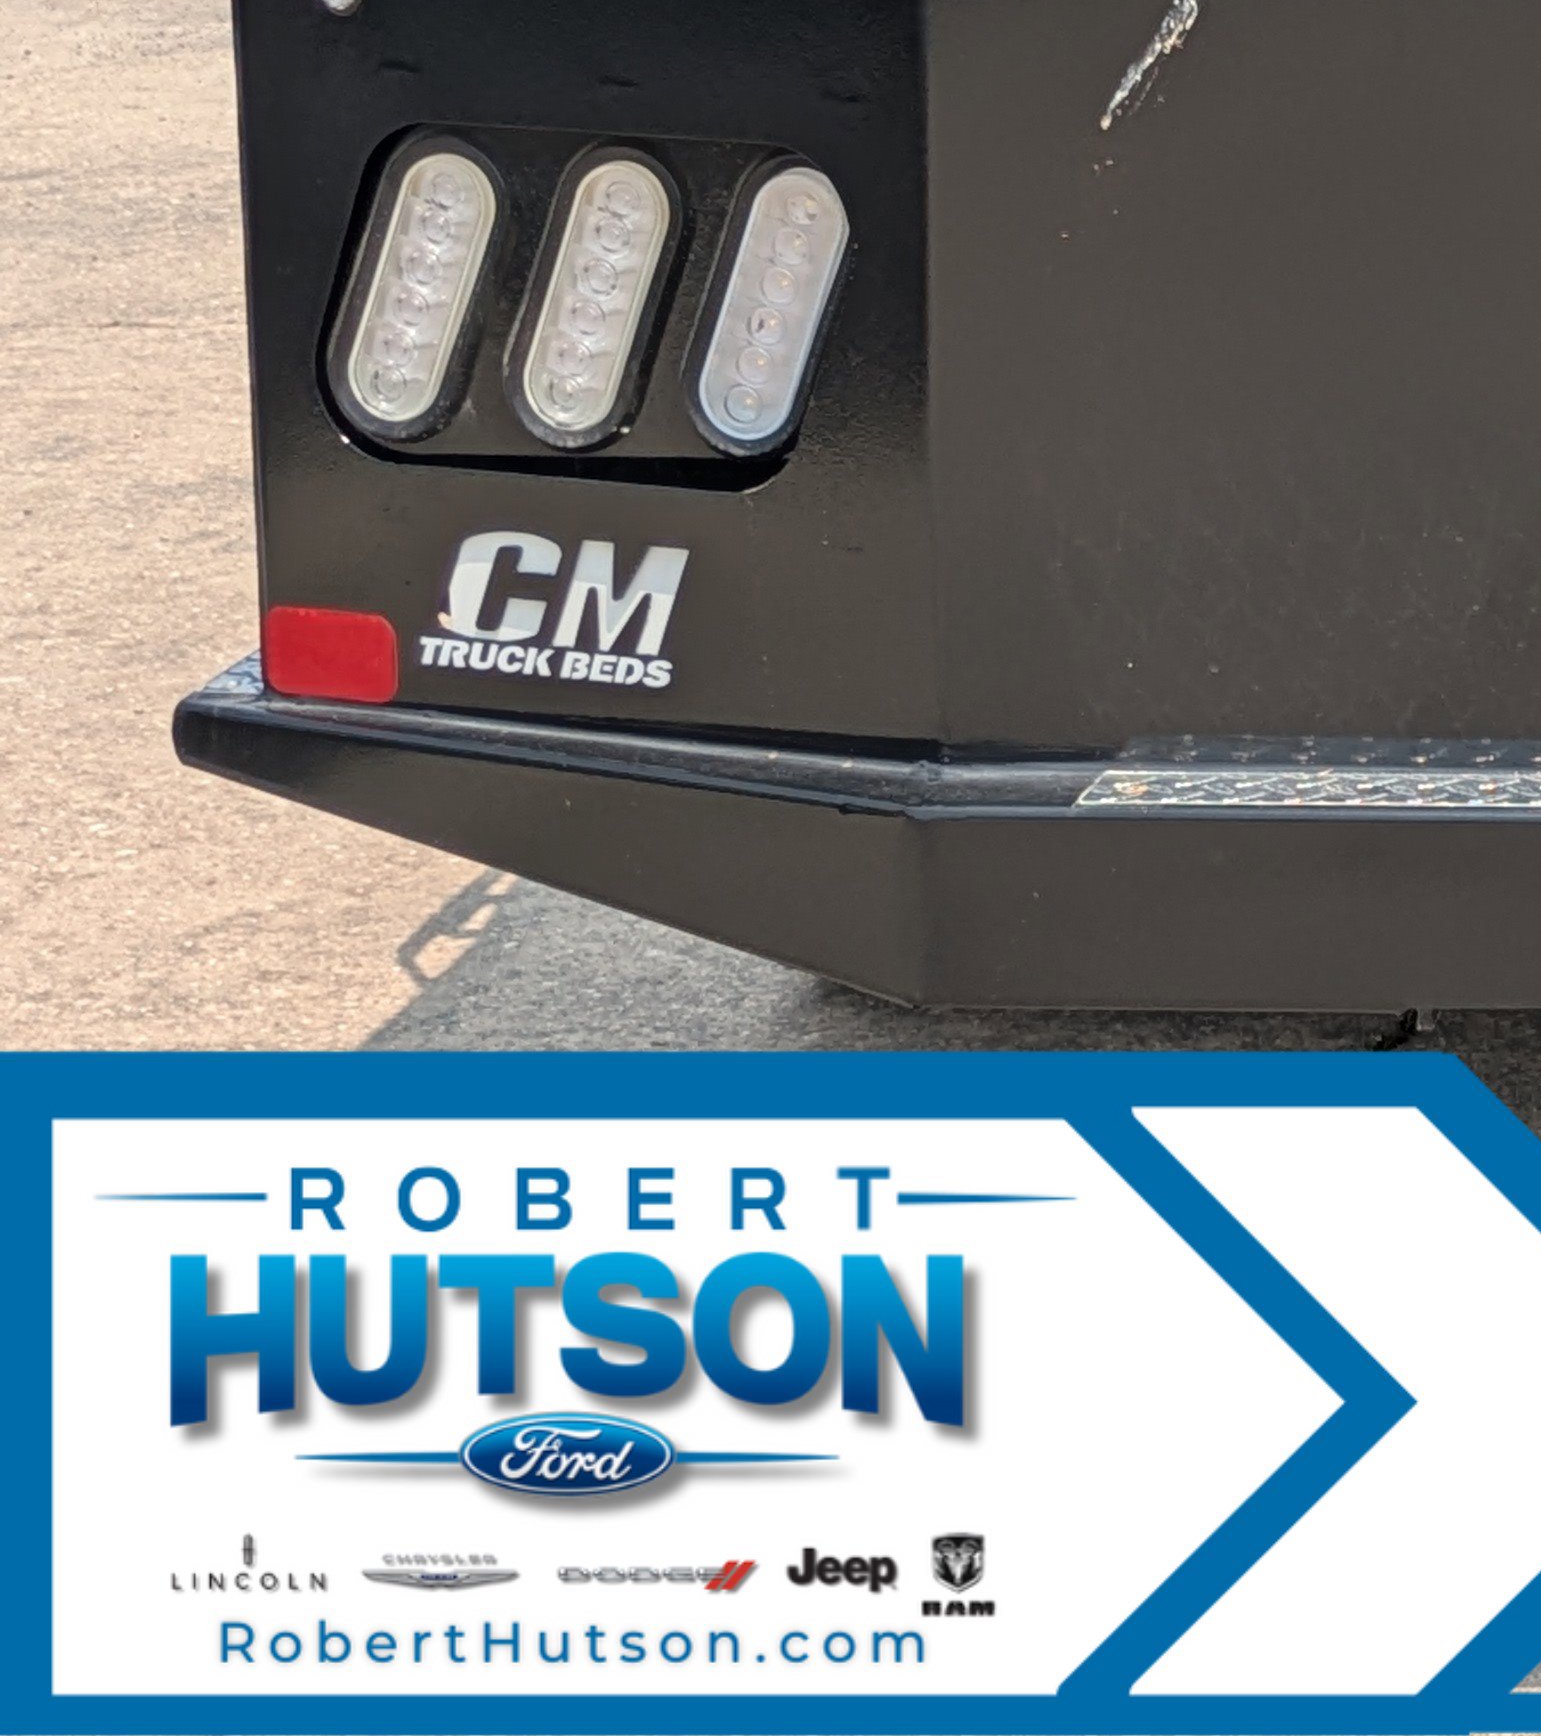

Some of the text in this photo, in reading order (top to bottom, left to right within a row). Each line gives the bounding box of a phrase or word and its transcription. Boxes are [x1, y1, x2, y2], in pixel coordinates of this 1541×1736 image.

[437, 529, 690, 657] CM
[418, 635, 674, 690] TRUCK BEDS
